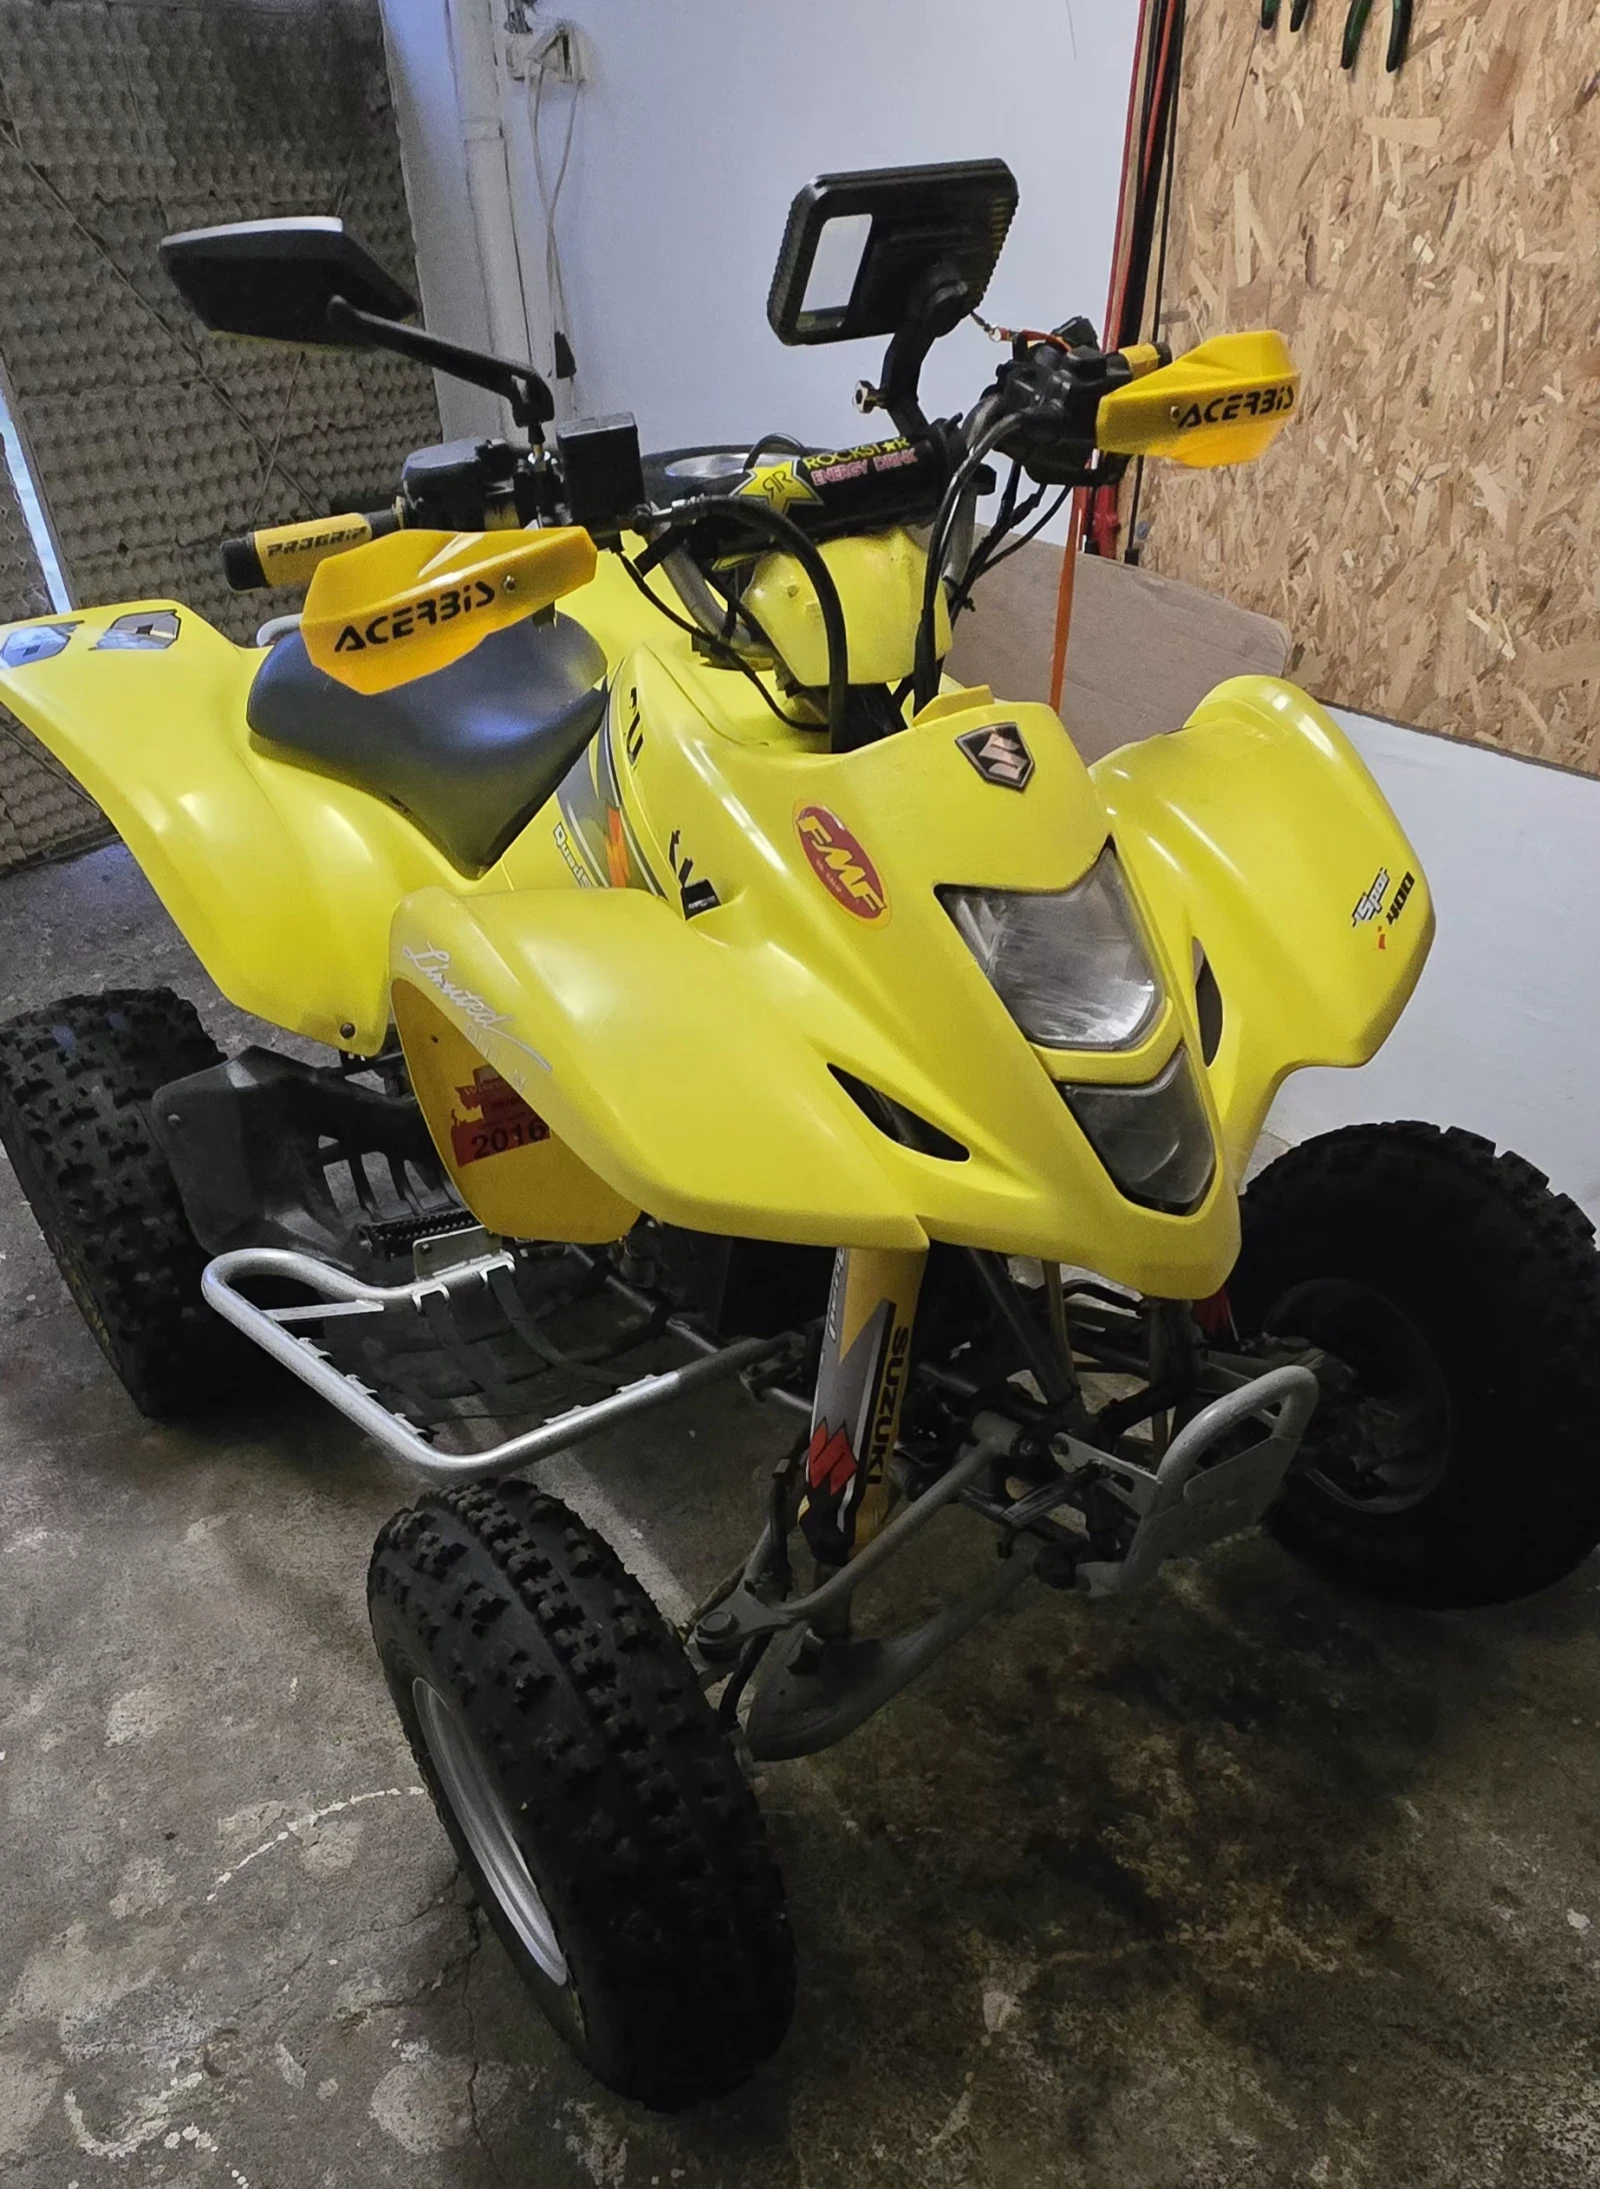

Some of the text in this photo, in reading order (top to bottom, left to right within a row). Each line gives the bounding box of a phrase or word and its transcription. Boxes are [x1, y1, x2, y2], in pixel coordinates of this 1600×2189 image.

[811, 447, 918, 487] ENERGY DRINK
[267, 525, 368, 557] PROGRIP
[797, 815, 886, 911] FMF
[1386, 870, 1415, 926] 400
[864, 1325, 909, 1485] SUZUKI
